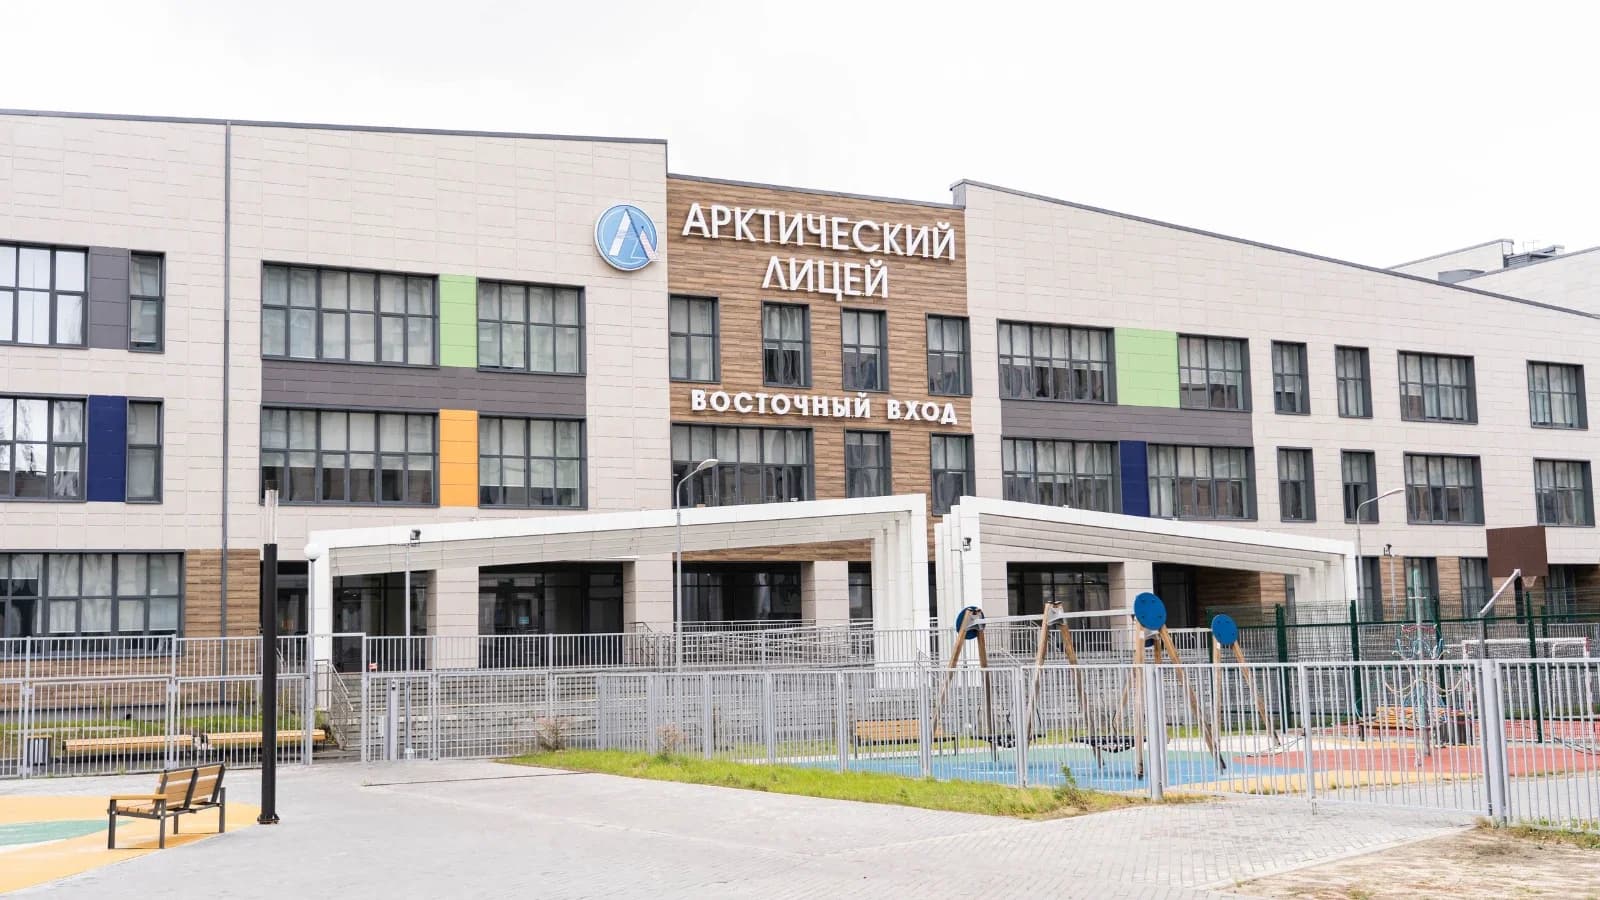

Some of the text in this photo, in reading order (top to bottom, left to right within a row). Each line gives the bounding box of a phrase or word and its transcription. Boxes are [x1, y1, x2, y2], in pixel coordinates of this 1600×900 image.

[682, 203, 956, 261] АРКТИЧЕСКИЙ
[762, 256, 888, 300] ЛИЦЕЙ
[691, 389, 958, 425] ВОСТОЧНЫЙ ВХОД
